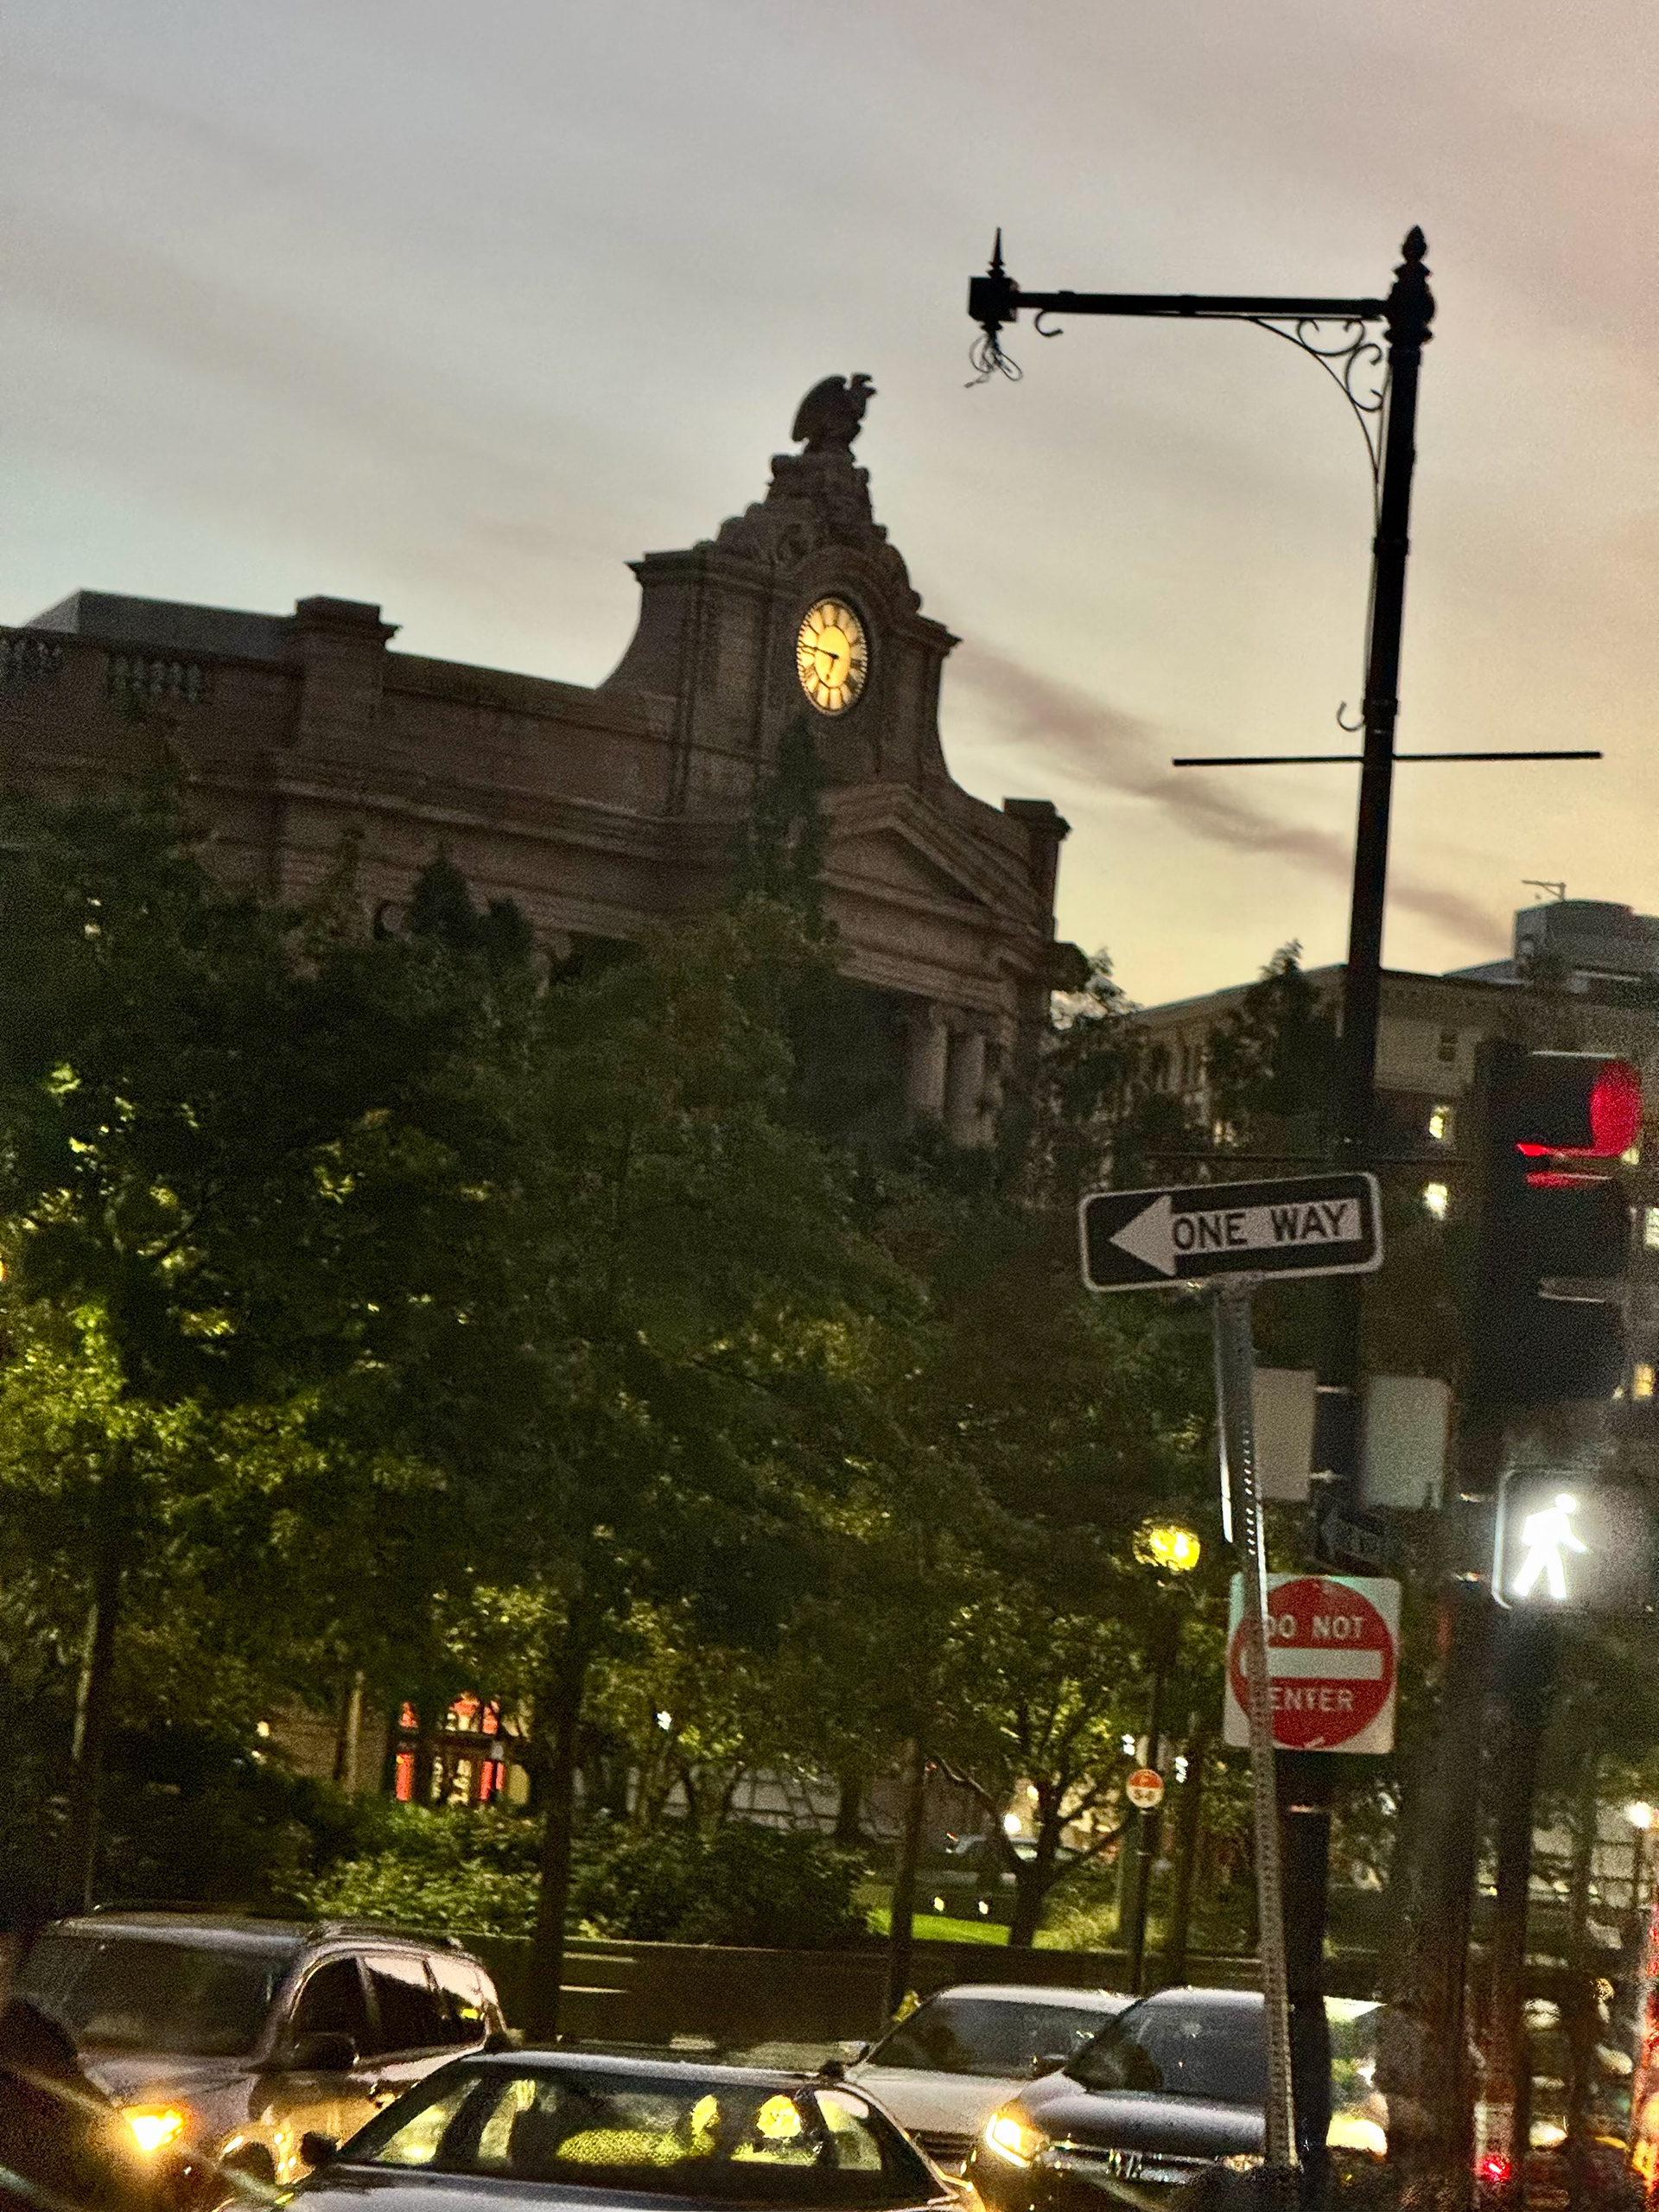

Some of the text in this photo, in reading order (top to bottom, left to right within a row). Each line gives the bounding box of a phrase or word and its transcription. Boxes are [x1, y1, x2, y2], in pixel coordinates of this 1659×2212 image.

[1172, 1202, 1348, 1251] ONE WAY
[1265, 1613, 1364, 1640] DO NOT
[1267, 1686, 1354, 1713] ENTER
